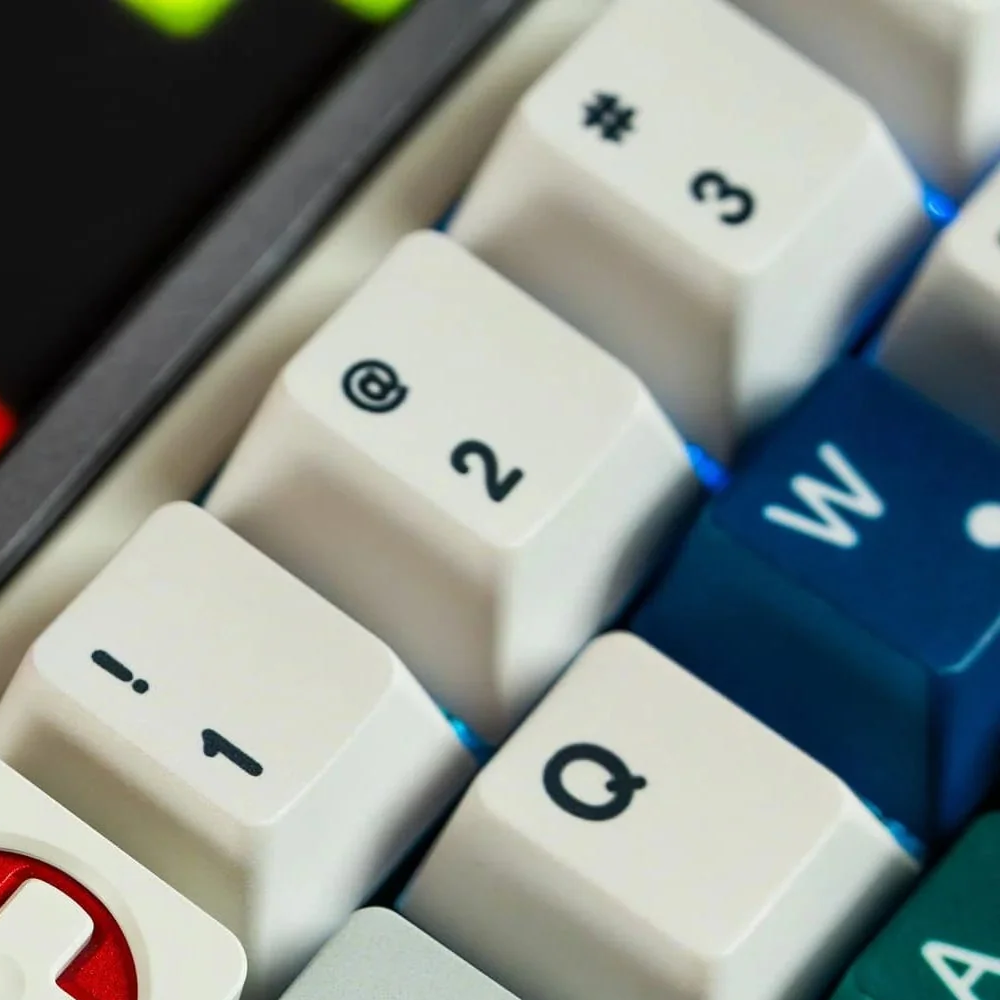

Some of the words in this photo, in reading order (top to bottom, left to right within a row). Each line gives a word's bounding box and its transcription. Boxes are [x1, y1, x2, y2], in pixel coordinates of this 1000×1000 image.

[583, 93, 636, 143] #
[689, 170, 756, 226] 3
[341, 359, 409, 414] @
[450, 439, 524, 503] 2
[765, 444, 885, 548] W
[90, 649, 150, 695] !
[201, 728, 264, 777] 1
[542, 742, 648, 822] Q
